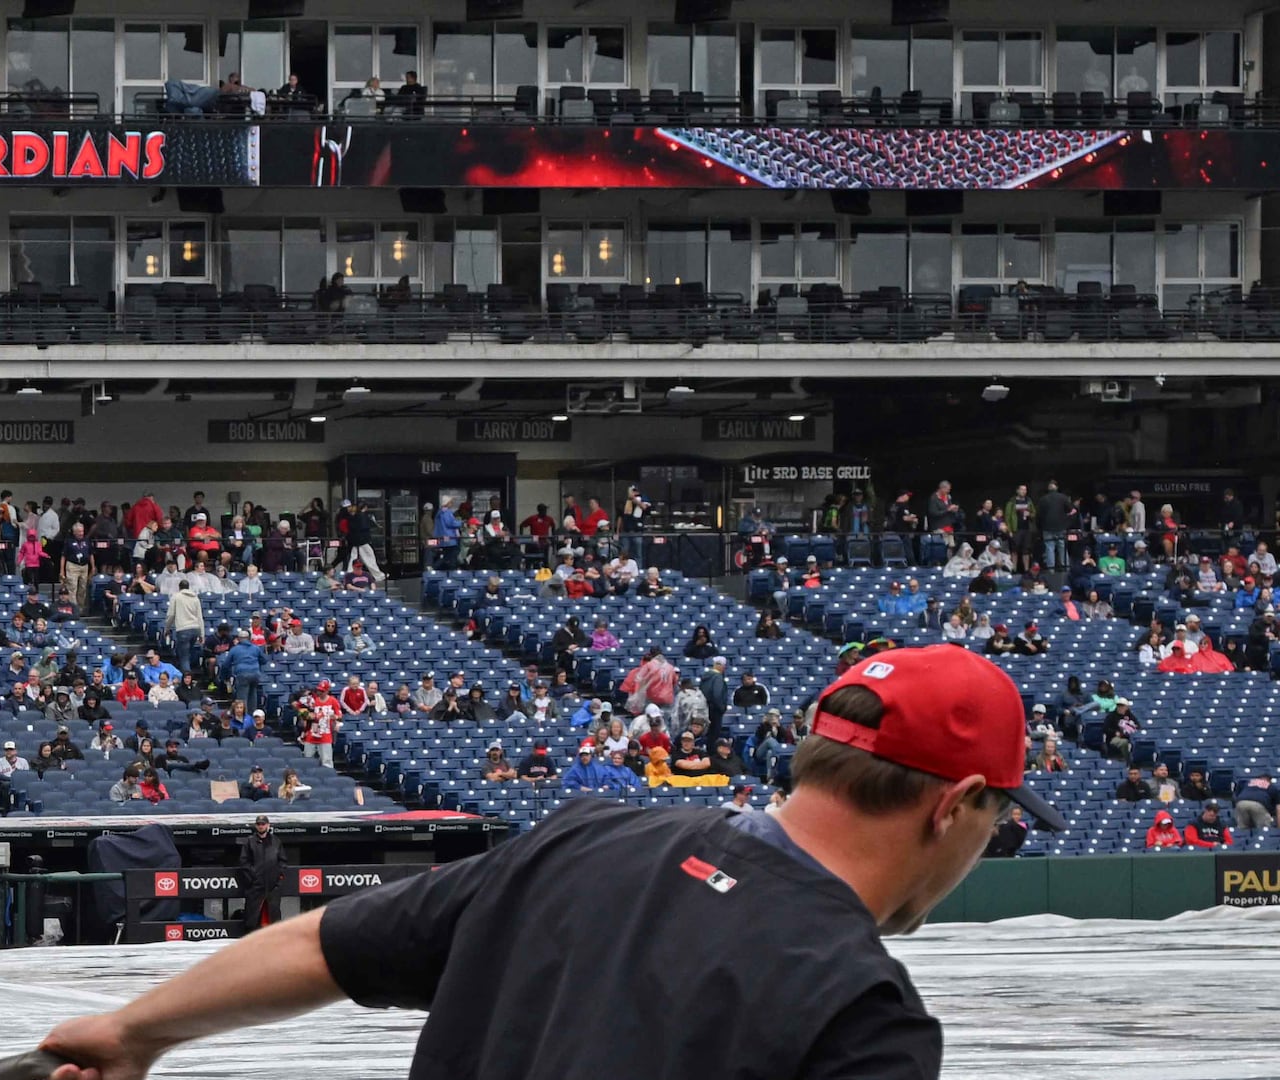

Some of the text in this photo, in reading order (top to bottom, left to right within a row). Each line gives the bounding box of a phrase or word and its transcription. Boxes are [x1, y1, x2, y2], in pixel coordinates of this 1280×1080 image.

[229, 421, 306, 440] BOB LEMON
[474, 422, 555, 439] LARRY DOBY
[719, 421, 801, 438] EARLY WYNN
[773, 467, 798, 480] 3RD
[802, 466, 833, 479] BASE
[836, 465, 870, 479] GRILL
[1154, 483, 1210, 492] GLUTEN FREE
[182, 877, 238, 890] TOYOTA
[326, 873, 382, 887] TOYOTA
[1223, 896, 1268, 906] Property
[186, 928, 228, 939] TOYOTA
